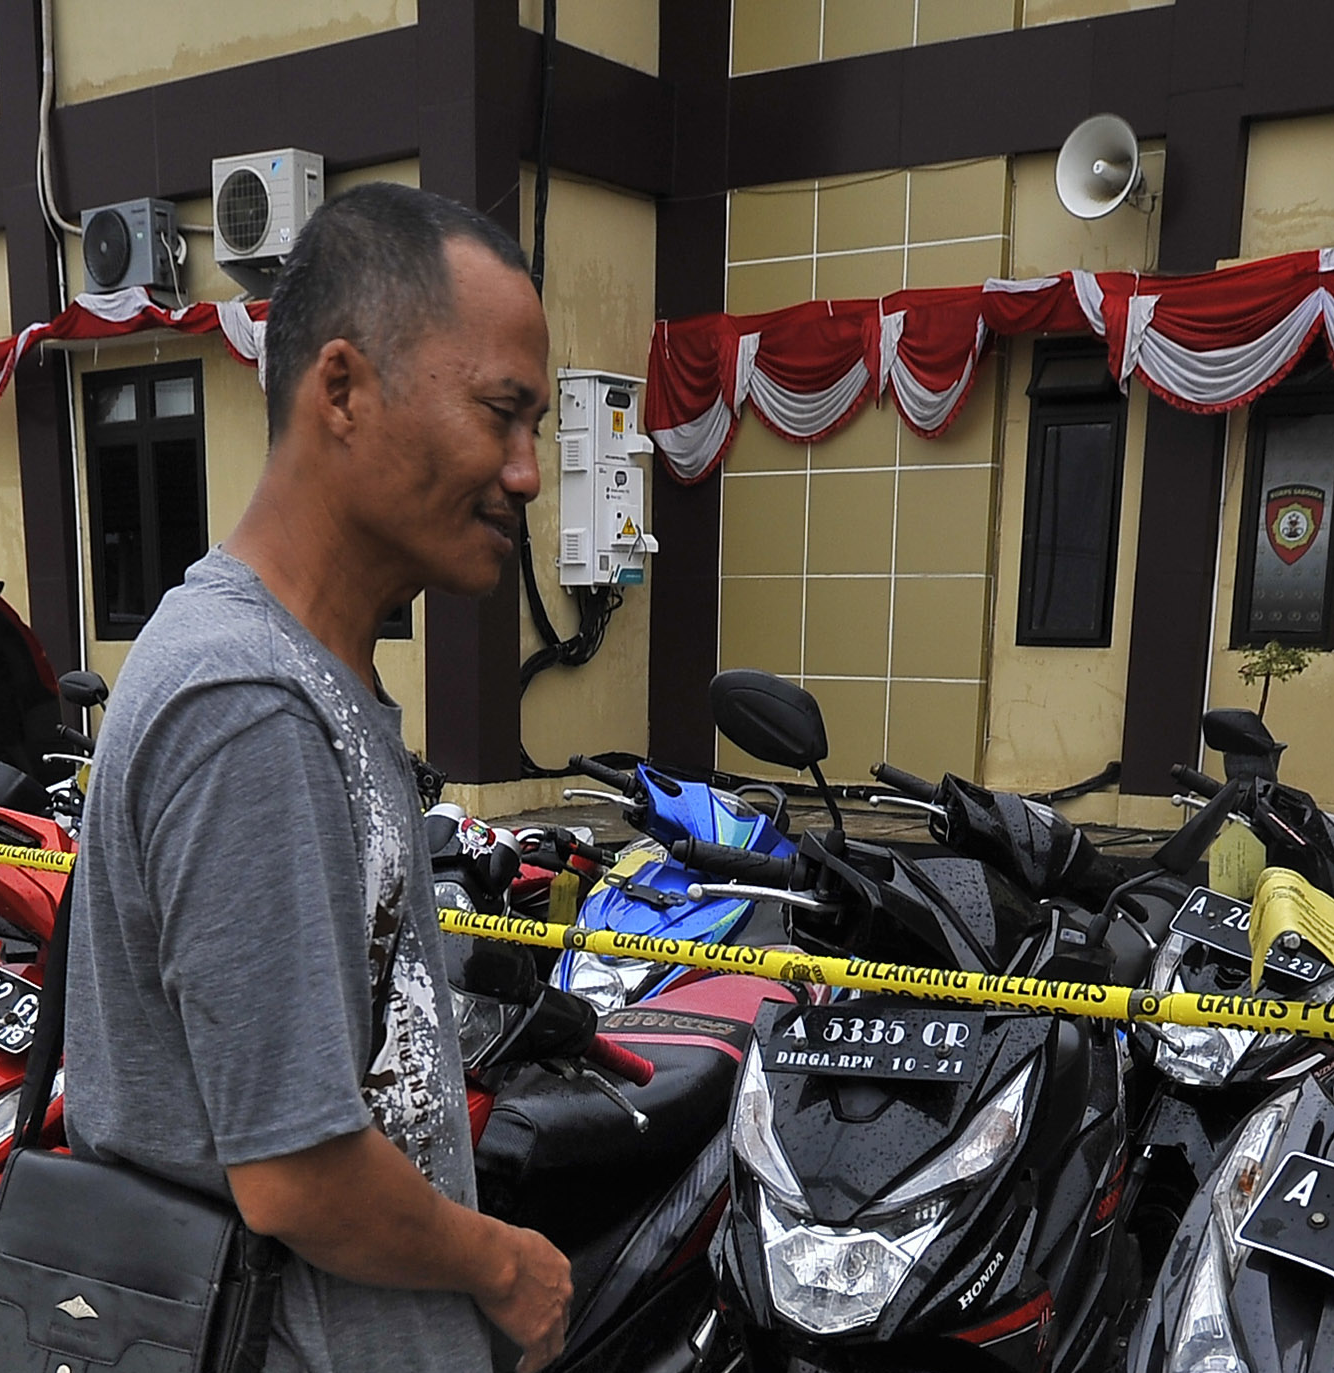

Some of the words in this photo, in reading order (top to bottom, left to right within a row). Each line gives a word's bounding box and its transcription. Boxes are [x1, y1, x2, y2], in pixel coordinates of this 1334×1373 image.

[1269, 488, 1292, 499] KORPS
[1293, 487, 1323, 499] SABHARA
[454, 911, 549, 938] MELINTAS
[1189, 896, 1208, 915] A
[1222, 907, 1251, 931] 20
[612, 932, 680, 955] GARIS
[688, 940, 768, 966] POLISI
[845, 960, 971, 988] DILARANG
[977, 974, 1109, 1003] MELINTAS
[1197, 994, 1289, 1019] GARIS
[782, 1016, 808, 1039] A
[823, 1018, 906, 1044] 5335
[922, 1022, 970, 1048] CR
[776, 1051, 875, 1068] DIRGA.RPN
[1283, 1170, 1319, 1207] A
[957, 1251, 1005, 1310] HONDA
